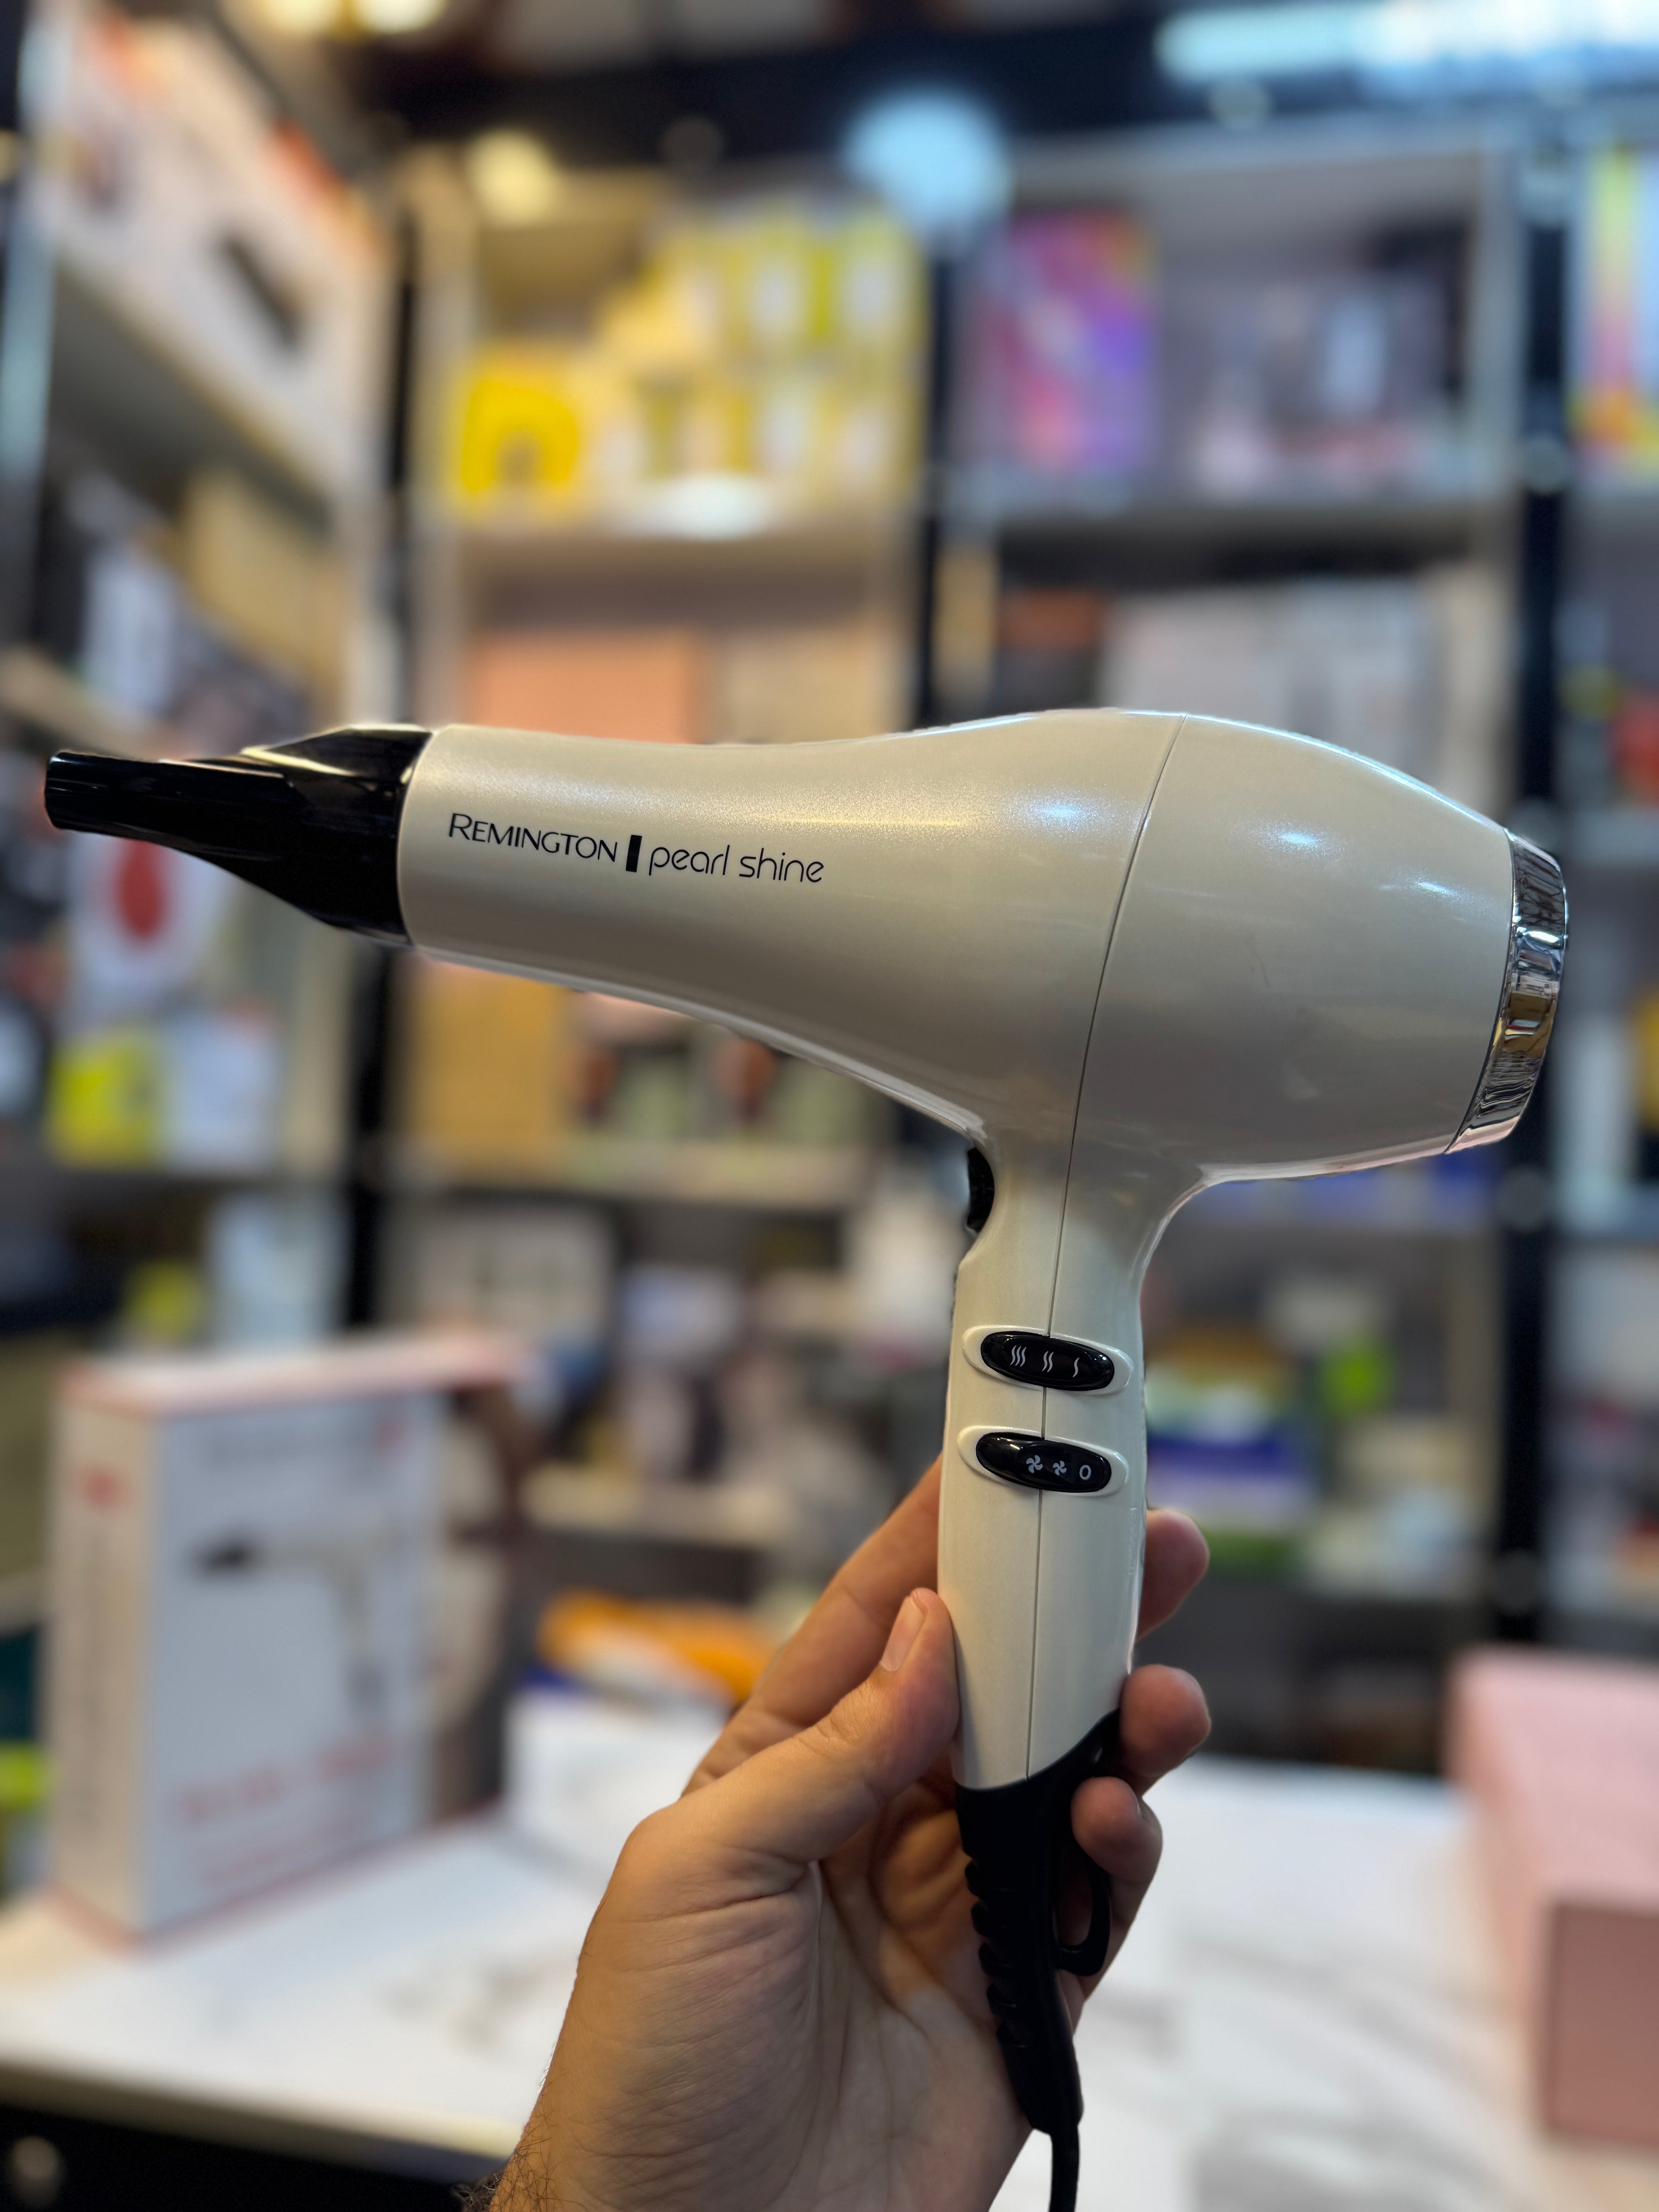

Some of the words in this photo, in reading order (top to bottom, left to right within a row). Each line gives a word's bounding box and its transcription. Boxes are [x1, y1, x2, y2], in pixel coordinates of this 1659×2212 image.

[448, 812, 618, 863] REMINGTON
[648, 844, 730, 876] pearl
[739, 848, 824, 883] shine
